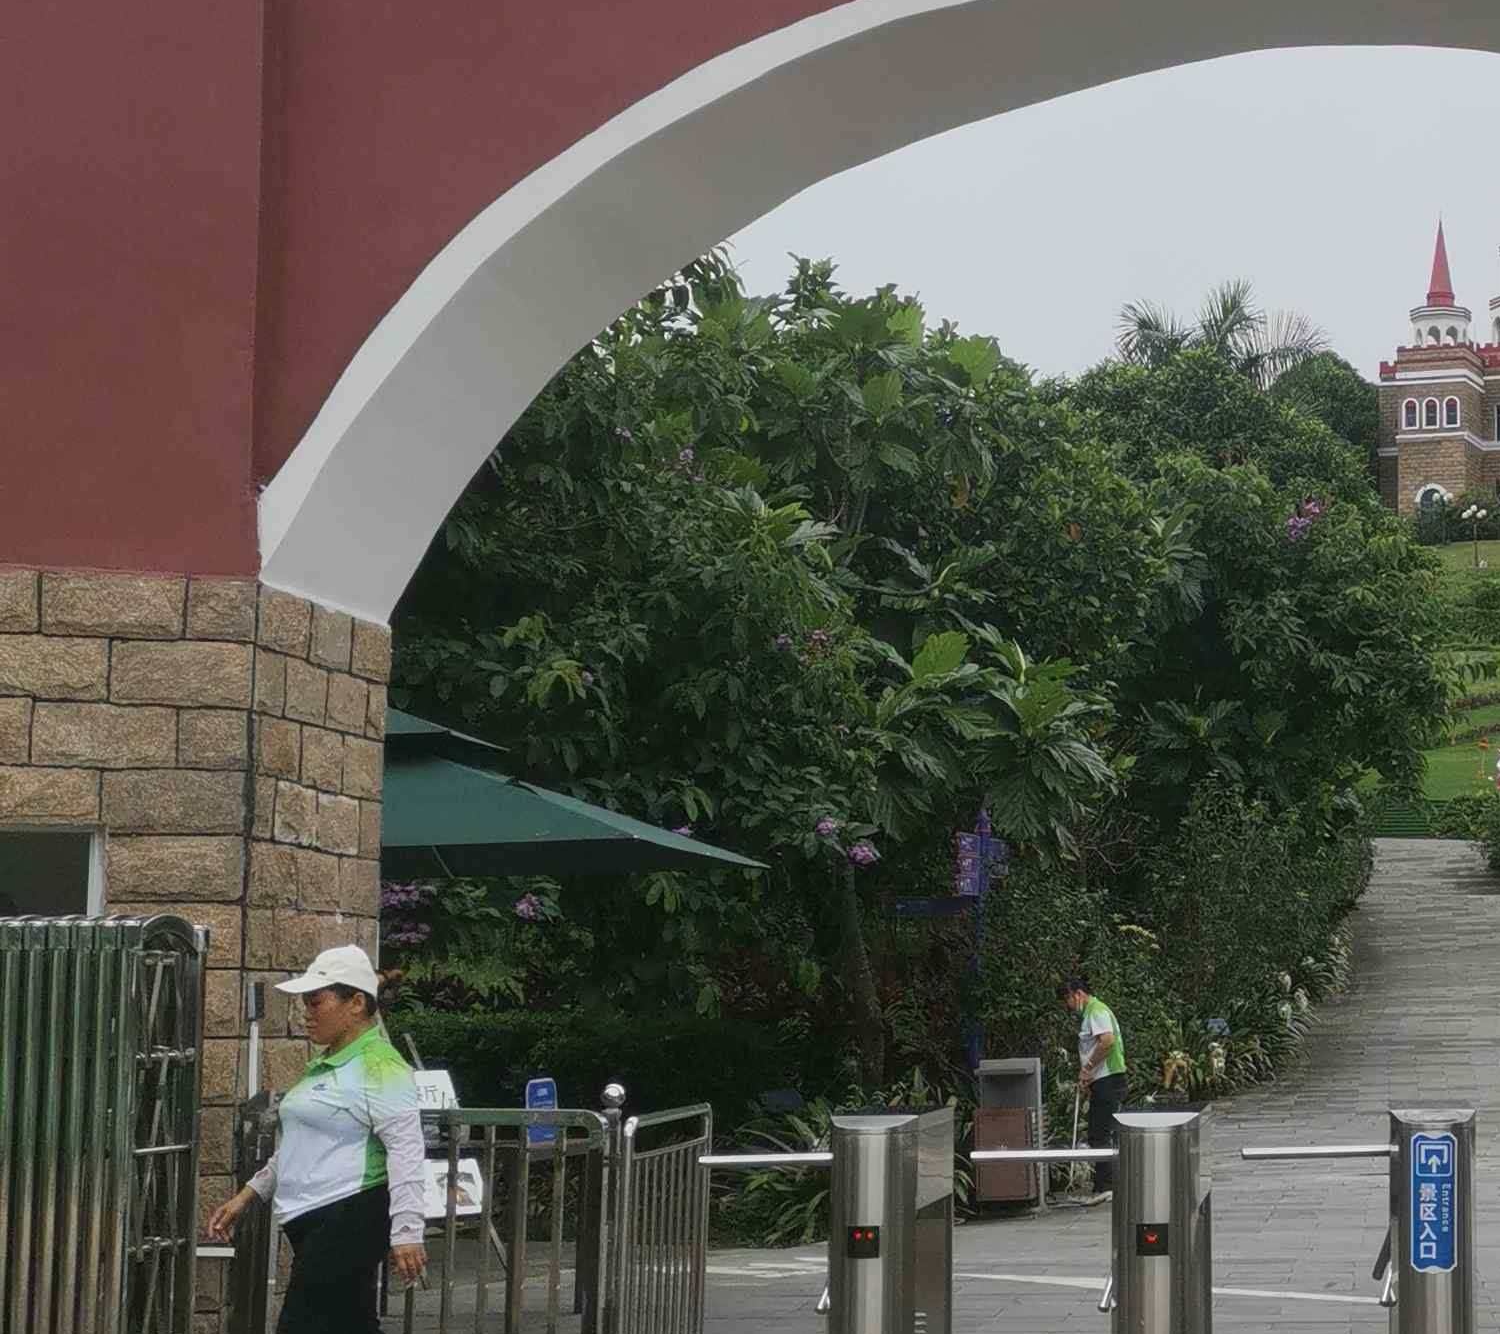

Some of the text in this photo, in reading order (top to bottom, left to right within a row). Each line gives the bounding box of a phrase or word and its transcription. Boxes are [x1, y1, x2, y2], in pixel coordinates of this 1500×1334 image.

[1419, 1183, 1438, 1259] 景区入口
[1442, 1183, 1451, 1232] Entrance
